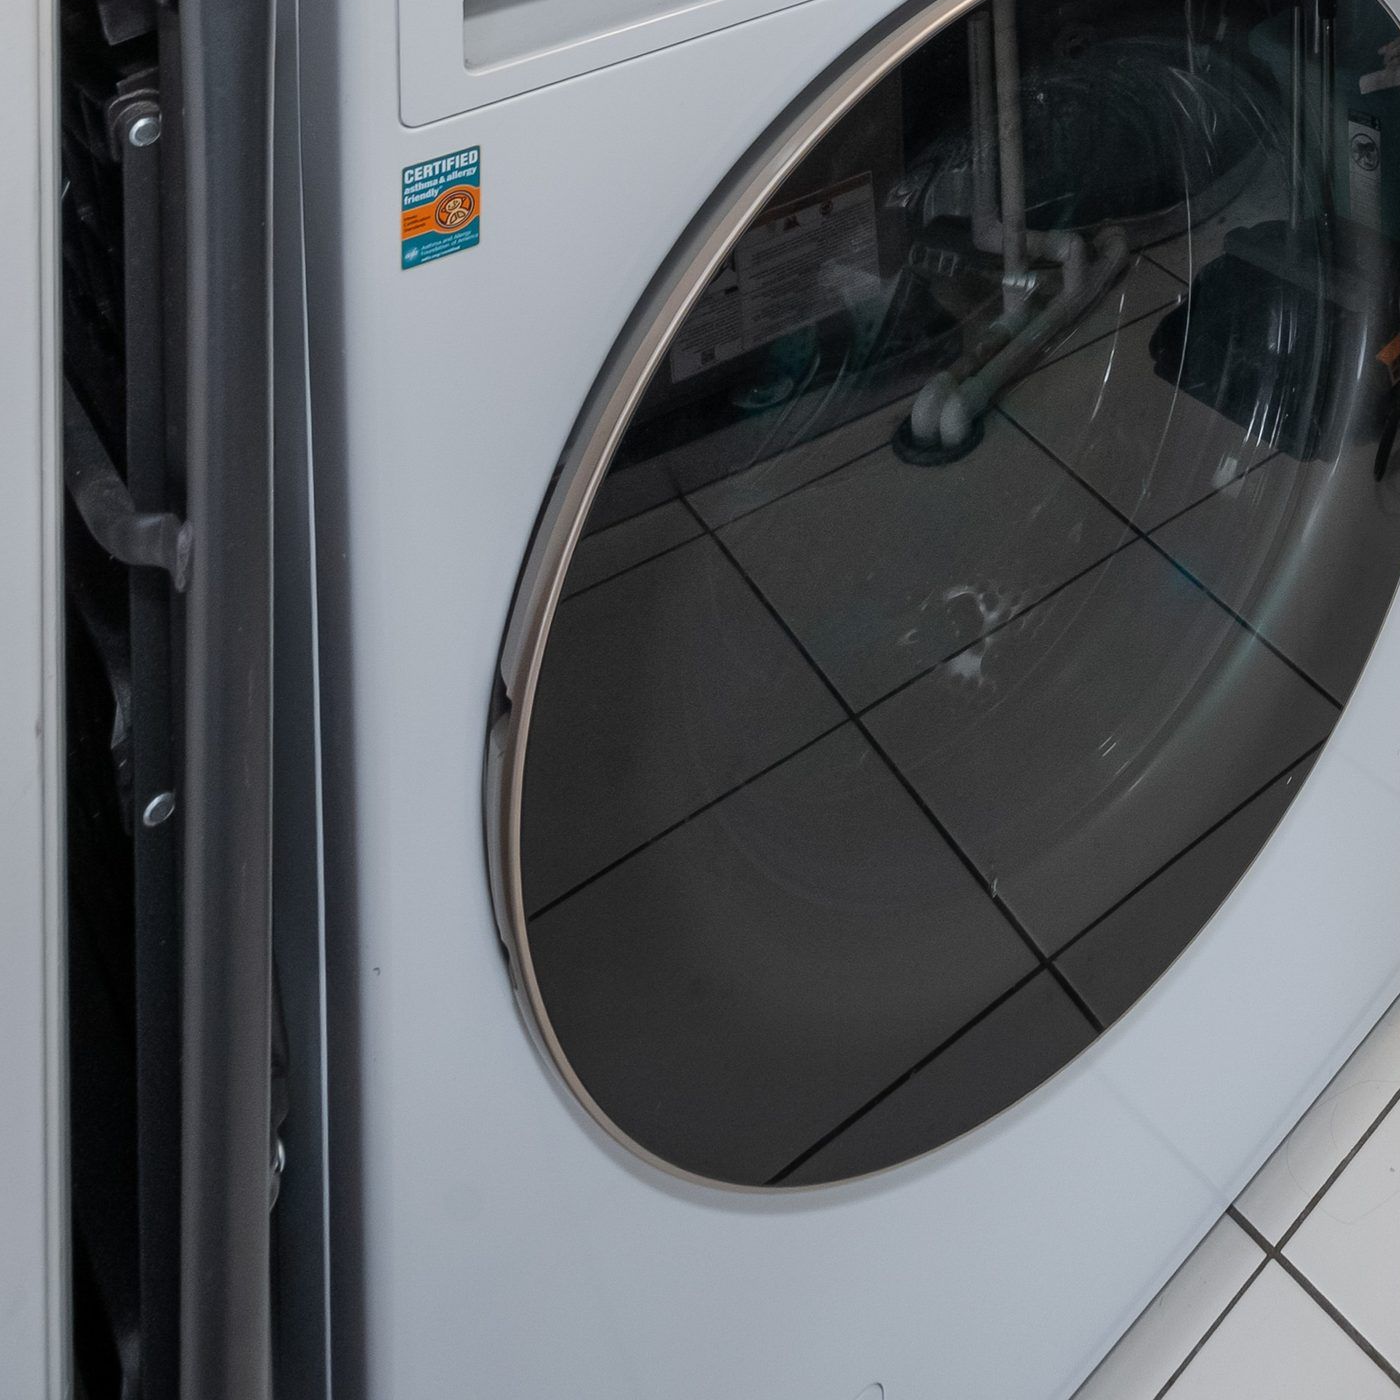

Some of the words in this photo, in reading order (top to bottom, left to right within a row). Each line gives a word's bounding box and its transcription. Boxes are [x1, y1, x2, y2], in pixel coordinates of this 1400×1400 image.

[404, 149, 479, 184] CERTIFIED
[404, 177, 438, 196] asthma
[446, 166, 478, 182] allergy
